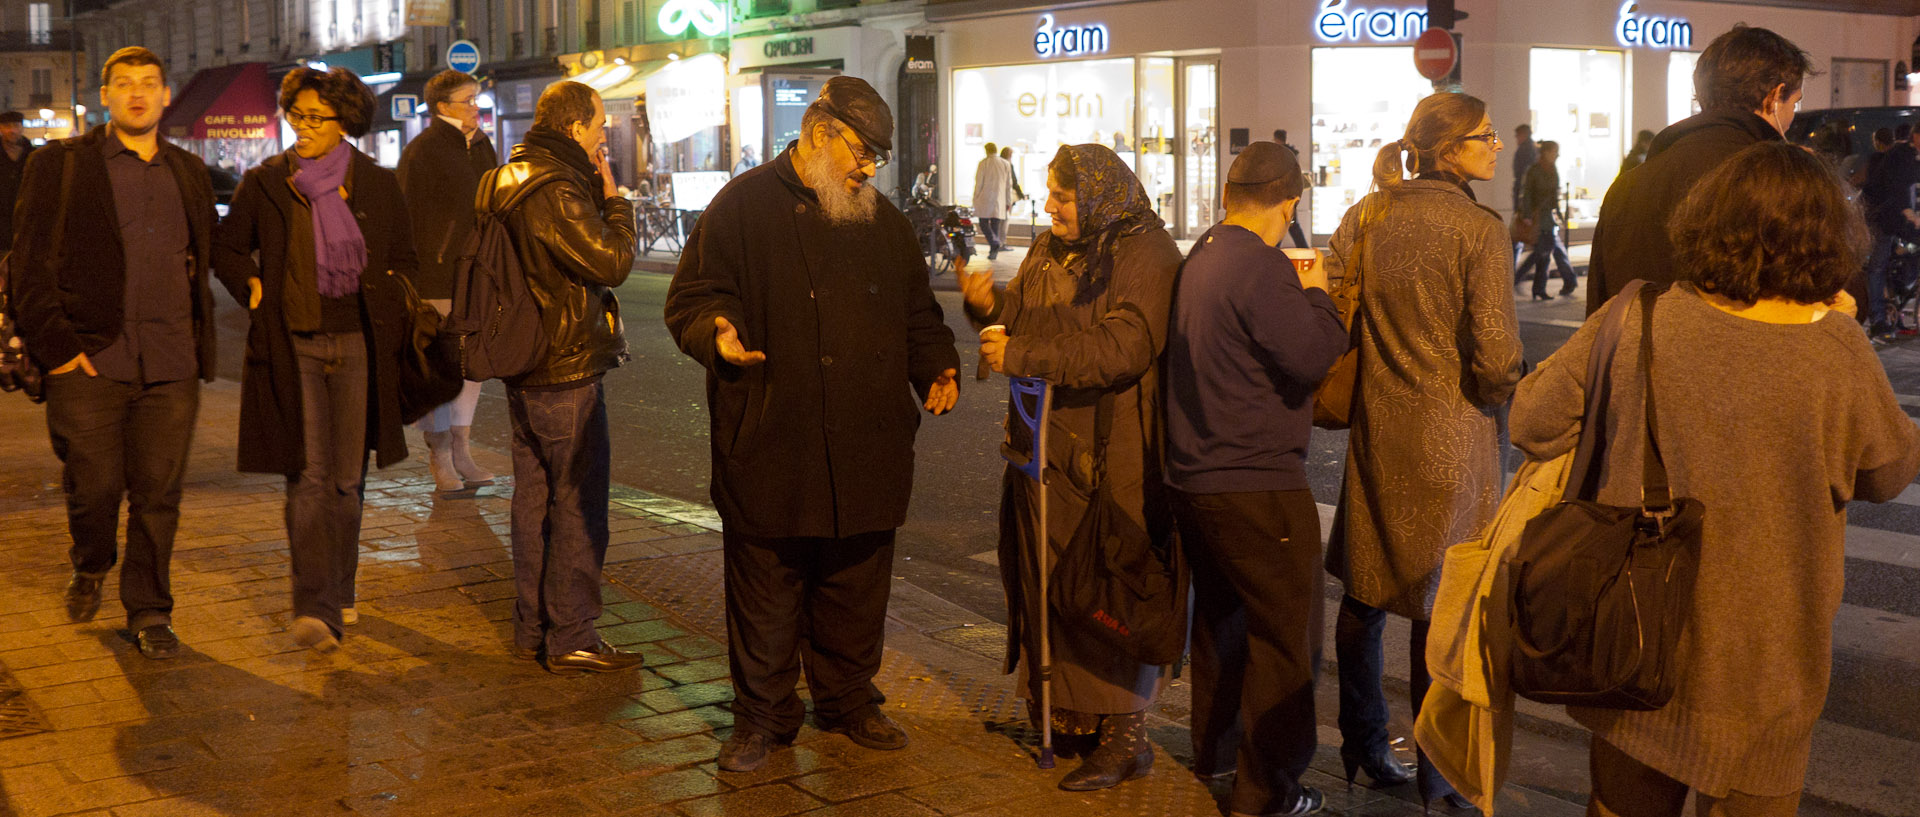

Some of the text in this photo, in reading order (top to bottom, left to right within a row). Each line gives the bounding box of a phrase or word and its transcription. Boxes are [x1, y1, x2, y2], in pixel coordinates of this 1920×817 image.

[1622, 3, 1692, 46] éram
[1034, 16, 1105, 55] éram
[907, 57, 934, 70] éram
[204, 115, 267, 125] CAFE BAR
[207, 127, 266, 139] RIVOLUX
